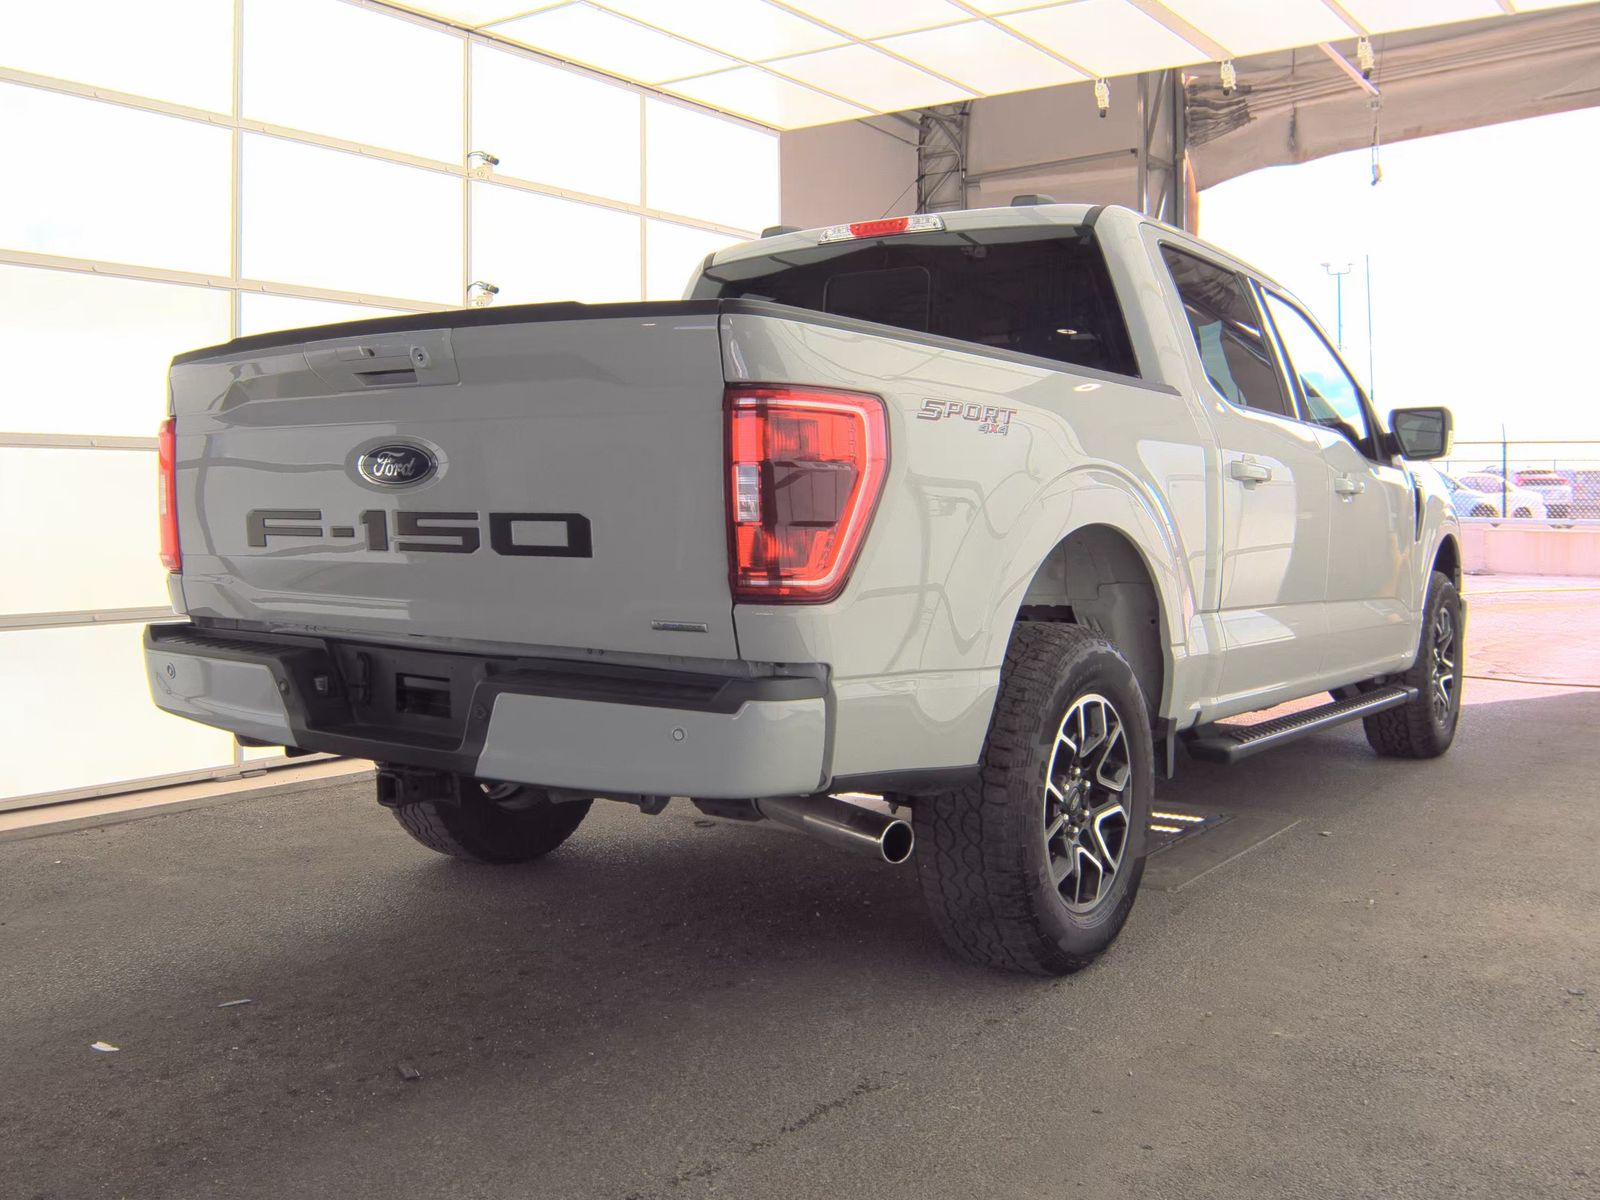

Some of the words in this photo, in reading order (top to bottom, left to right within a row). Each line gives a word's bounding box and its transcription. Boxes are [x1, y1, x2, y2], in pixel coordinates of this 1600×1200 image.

[917, 398, 1017, 425] SPORT
[373, 451, 416, 477] Ford
[246, 508, 593, 558] F-150
